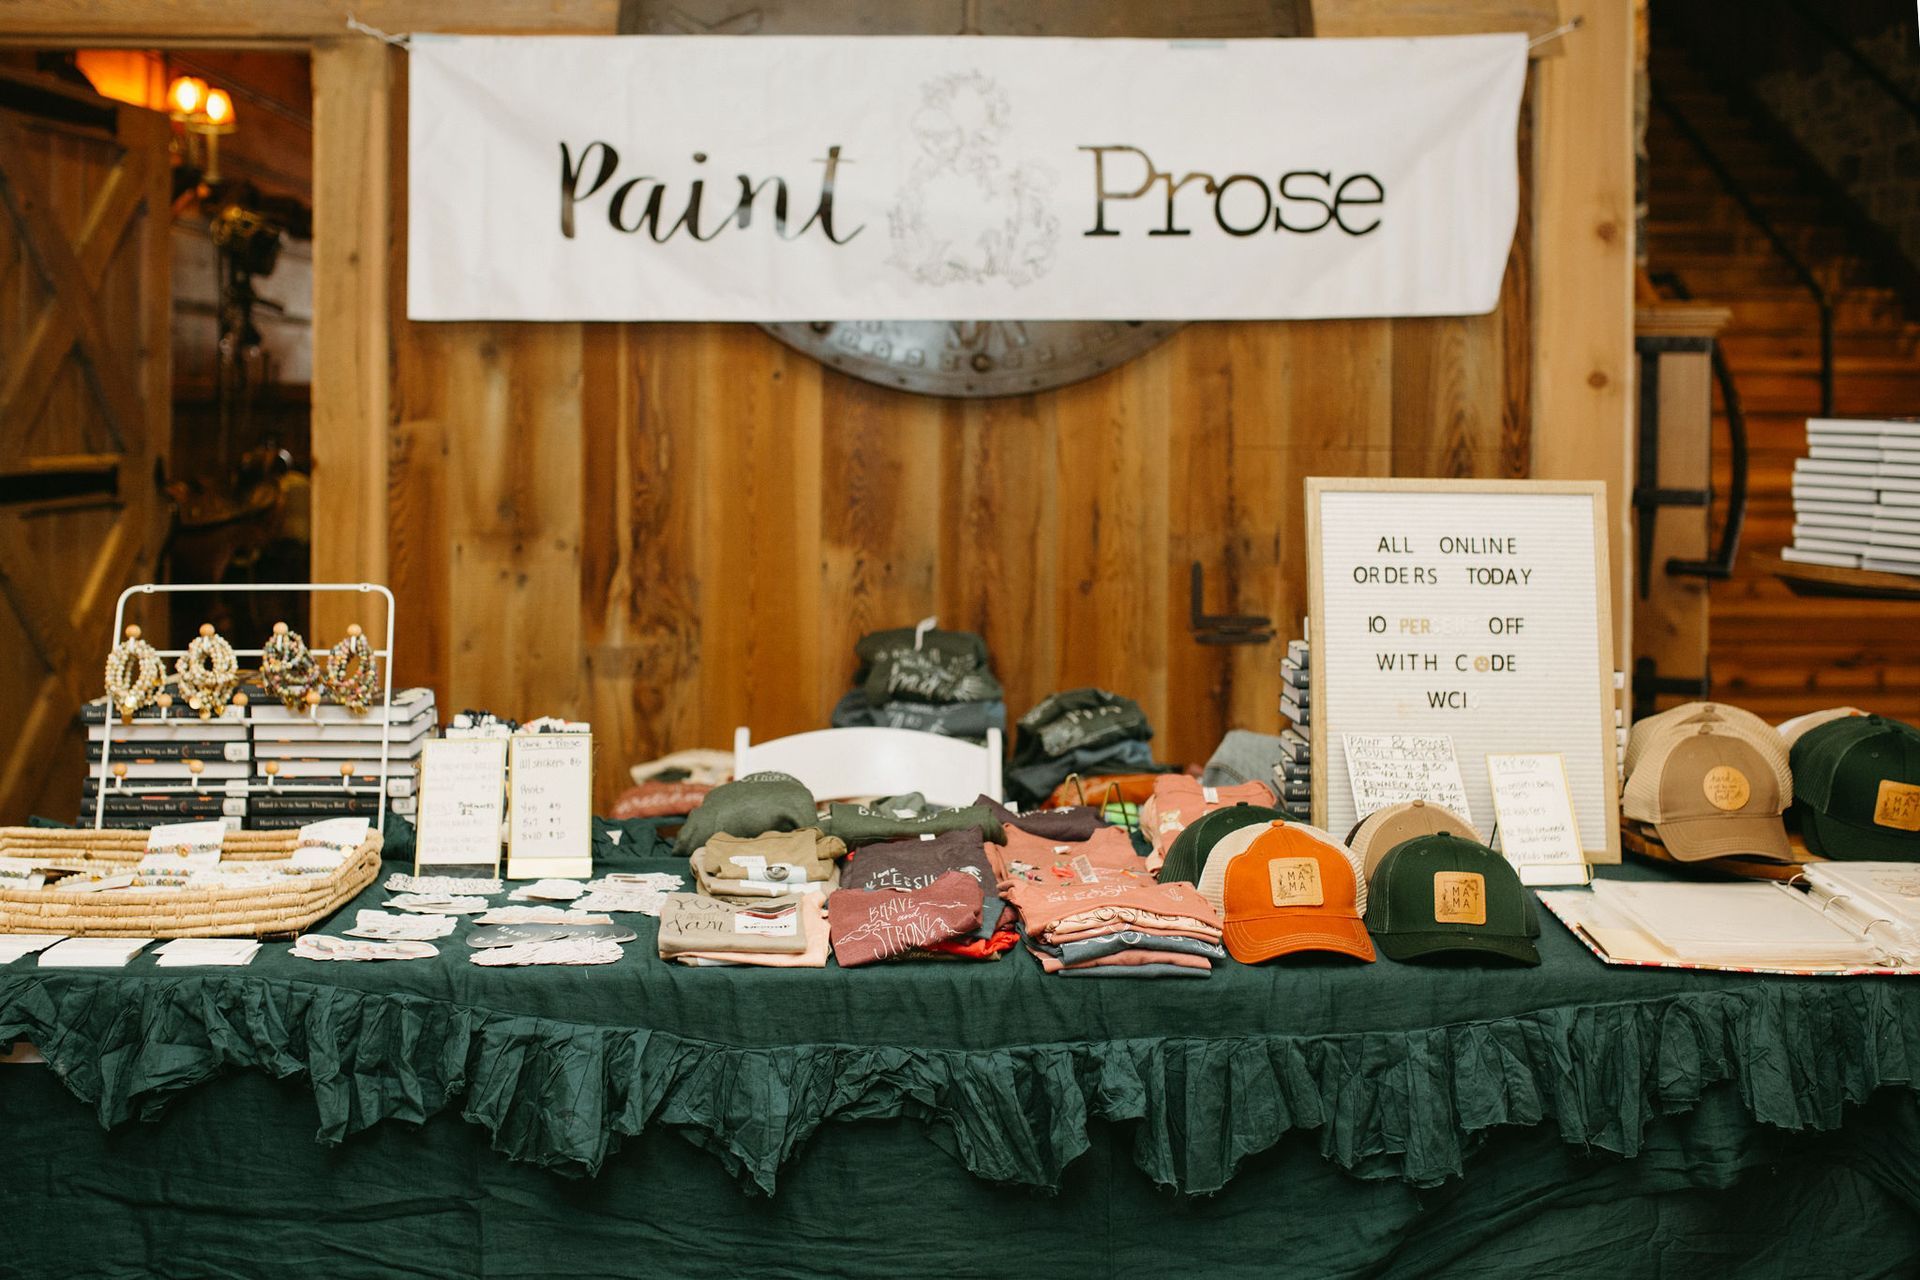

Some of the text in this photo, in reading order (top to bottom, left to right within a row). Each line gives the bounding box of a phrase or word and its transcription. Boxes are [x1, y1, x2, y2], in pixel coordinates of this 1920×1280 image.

[560, 141, 866, 245] Paint
[1078, 145, 1384, 236] Prose
[1377, 536, 1518, 554] ALL ONLINE
[1353, 566, 1532, 585] ORDERS TODAY
[1488, 616, 1525, 635] OFF
[1376, 653, 1438, 671] WITH
[1287, 871, 1306, 881] MA
[1288, 881, 1307, 891] MA
[1452, 886, 1470, 897] MA
[869, 898, 916, 923] BRAVE
[1453, 898, 1470, 909] MA
[897, 907, 919, 922] and
[872, 914, 931, 960] STRONG
